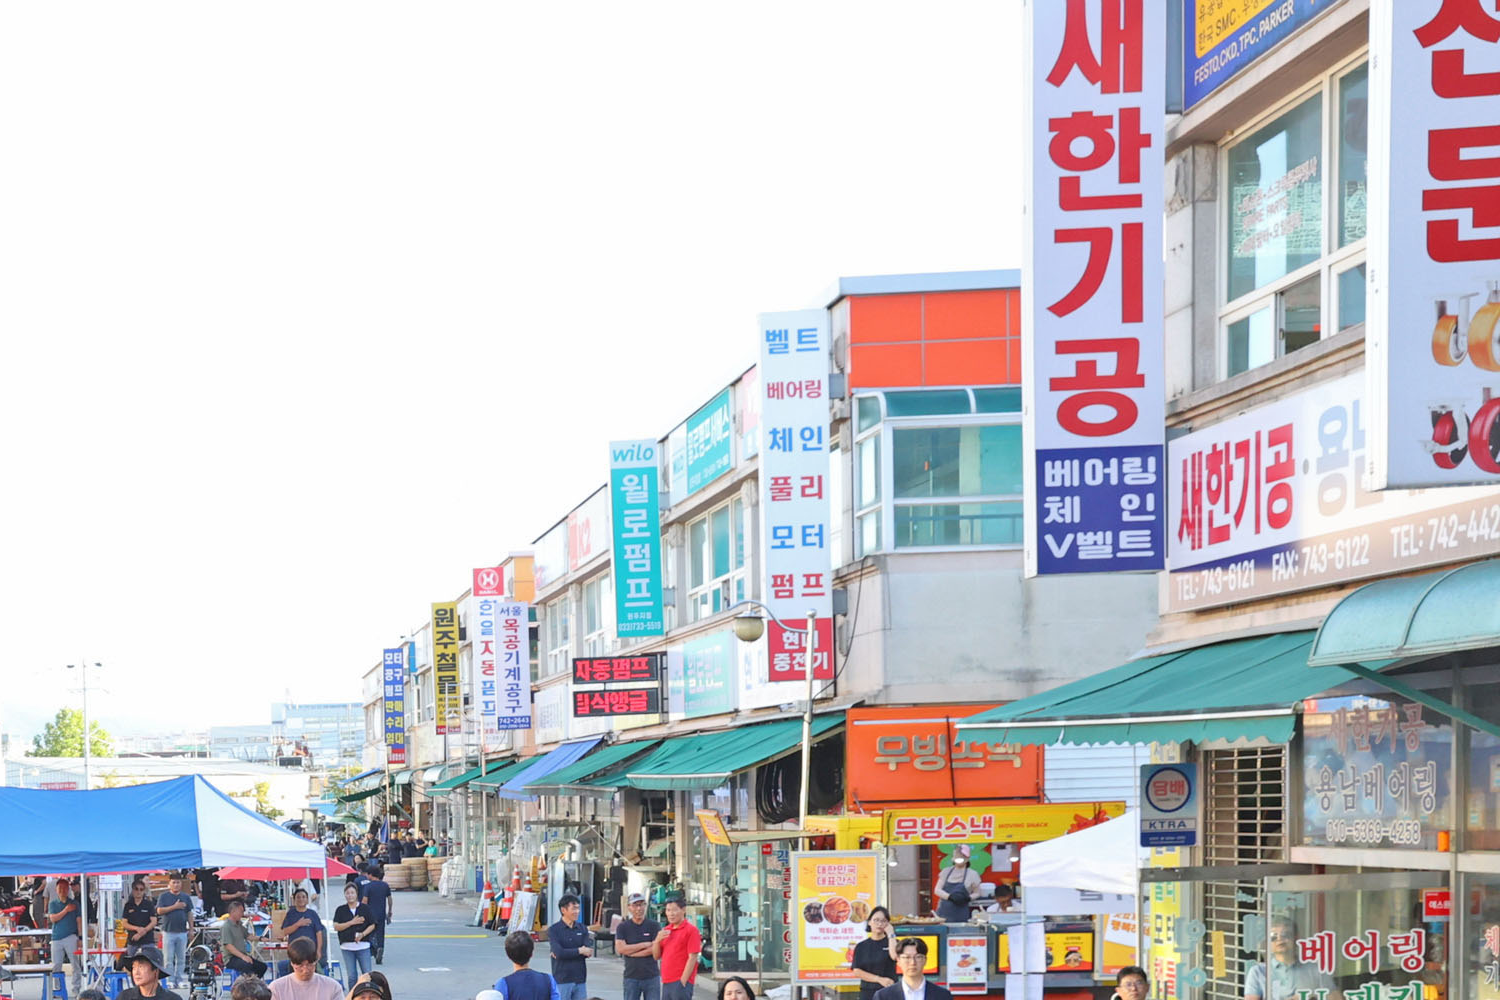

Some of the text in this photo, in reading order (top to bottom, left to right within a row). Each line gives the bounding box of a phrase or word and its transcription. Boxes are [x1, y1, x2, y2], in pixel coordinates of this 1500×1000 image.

[1047, 0, 1151, 437] 새한기공
[765, 327, 820, 355] 벨트
[766, 378, 822, 401] 베어링
[768, 425, 823, 453] 체인
[612, 443, 654, 465] wilo
[1044, 456, 1156, 488] 베어링
[770, 475, 824, 502] 풀리
[1178, 423, 1295, 551] 새한기공
[1044, 493, 1155, 524] 체인
[619, 473, 654, 608] 윌로펌프
[771, 523, 825, 551] 모터
[1044, 528, 1155, 560] V벨트
[1176, 569, 1200, 601] TEL:
[1201, 558, 1255, 598] 743-6121
[1272, 550, 1299, 582] FAX:
[1302, 534, 1370, 577] 743-6122
[1390, 522, 1424, 558] TEL:
[771, 572, 826, 599] 펌프
[500, 606, 522, 616] 서울
[385, 652, 403, 664] 모터
[434, 607, 458, 694] 원주철물
[385, 668, 403, 681] 공구
[502, 618, 522, 713] 목공기계공구
[575, 657, 651, 681] 자동펌프
[385, 700, 403, 713] 판매
[386, 716, 404, 729] 수리
[1327, 701, 1427, 755] 새한기공
[1153, 780, 1185, 797] 담배
[1315, 761, 1437, 814] 용남베어링
[894, 814, 995, 841] 무빙스낵
[1149, 820, 1187, 829] KTRA
[1326, 819, 1422, 844] 010-5369-4258
[817, 865, 856, 875] 대한민국
[817, 877, 857, 886] 대표간식
[1297, 928, 1426, 975] 베어링
